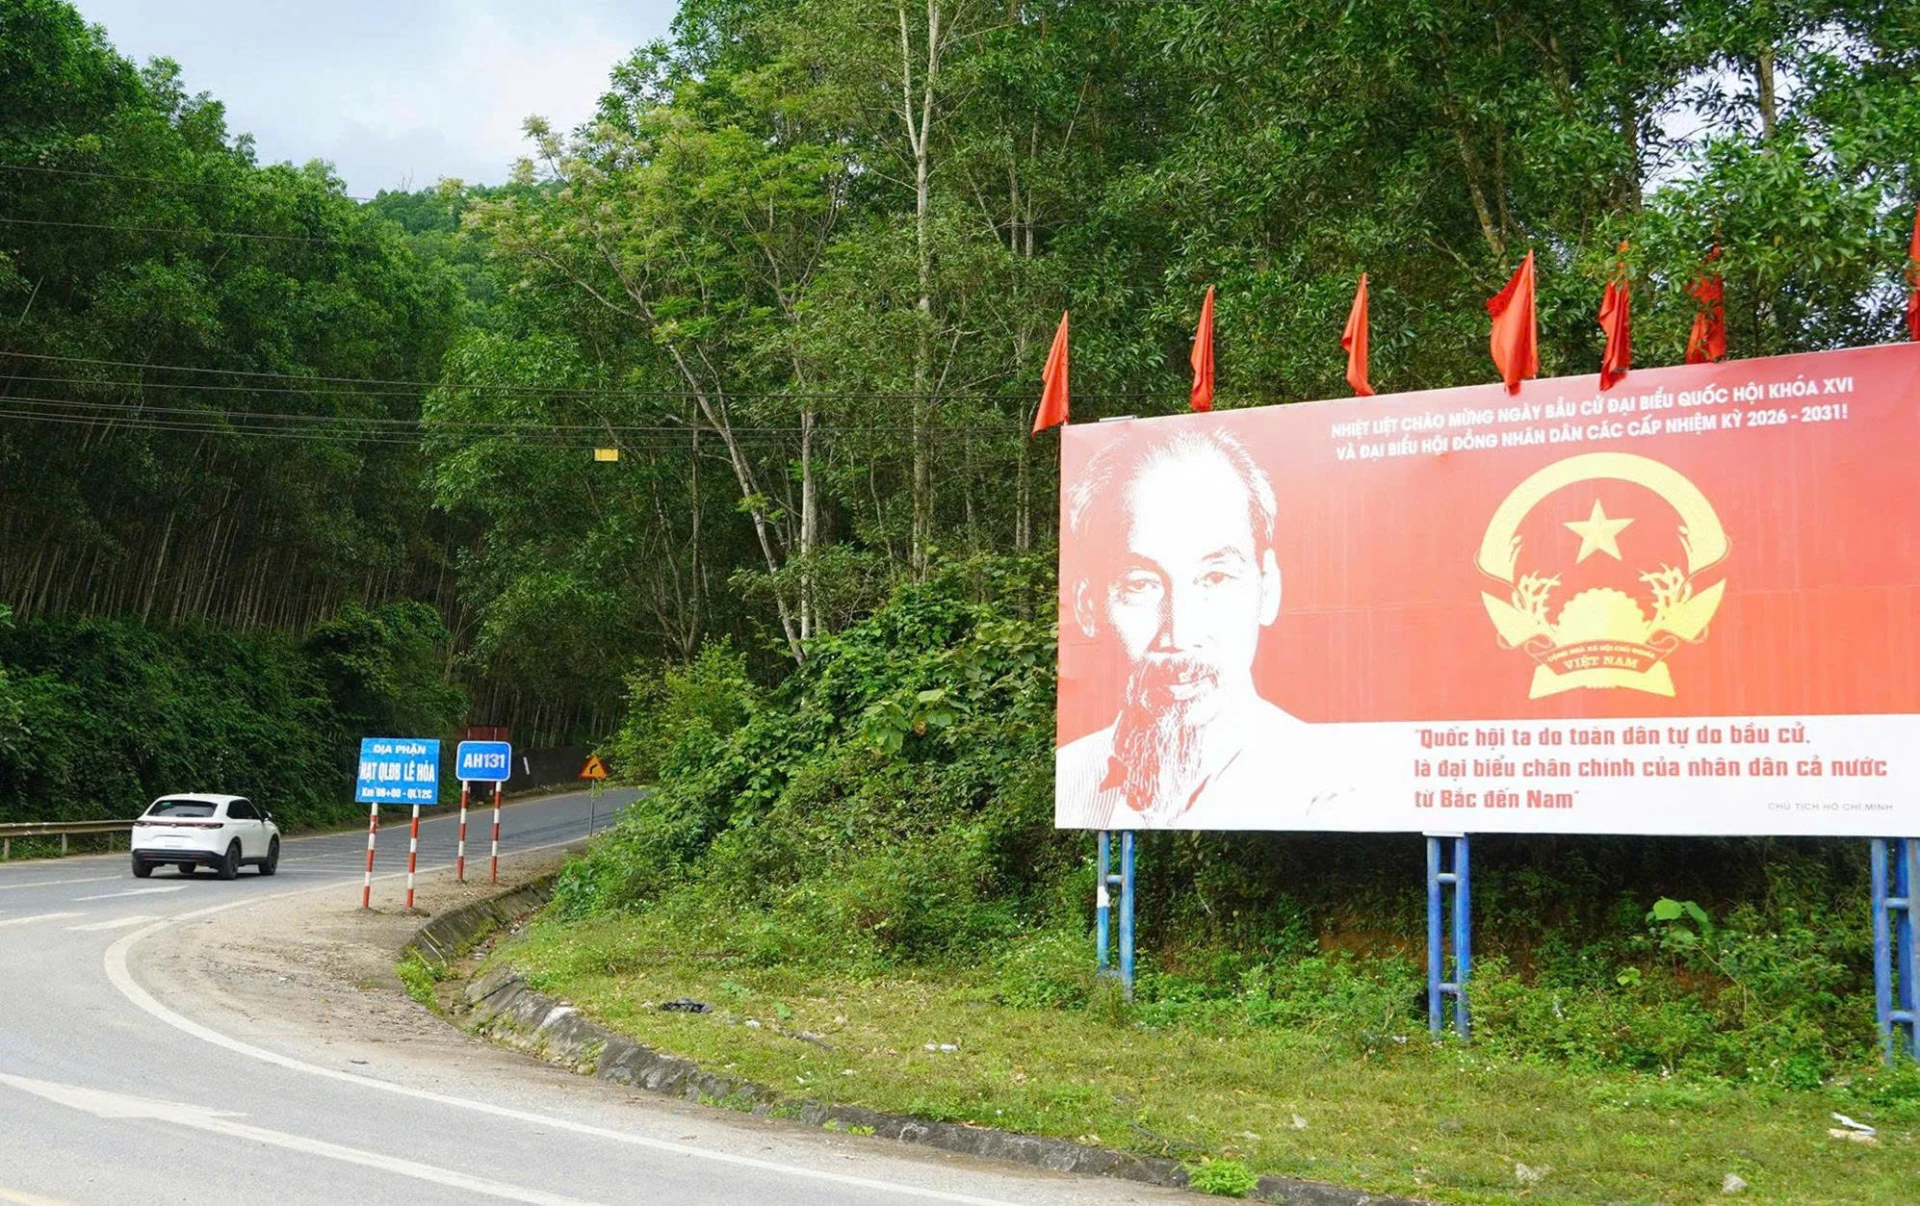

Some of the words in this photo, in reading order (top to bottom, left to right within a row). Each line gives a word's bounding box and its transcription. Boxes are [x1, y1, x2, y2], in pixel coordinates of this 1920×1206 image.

[1331, 421, 1368, 440] NHIỆT
[1373, 418, 1398, 437] LIỆT
[1401, 412, 1445, 431] CHÀO
[1449, 408, 1494, 426] MỪNG
[1498, 403, 1541, 422] NGÀY
[1546, 397, 1576, 419] BẦU
[1580, 397, 1604, 417] CỬ
[1608, 398, 1635, 414] ĐẠI
[1640, 386, 1673, 410] BIỂU
[1678, 383, 1728, 406] QUỐC
[1733, 382, 1764, 404] HỘI
[1769, 375, 1817, 398] KHÓA
[1823, 377, 1853, 393] XVI
[1336, 442, 1356, 460] VÀ
[1360, 442, 1384, 461] ĐẠI
[1388, 433, 1417, 456] BIỂU
[1422, 434, 1448, 456] HỘI
[1452, 427, 1498, 449] ĐỒNG
[1502, 427, 1545, 447] NHÂN
[1550, 423, 1582, 442] DÂN
[1586, 420, 1624, 439] CÁC
[1627, 413, 1662, 437] CẤP
[1666, 411, 1716, 435] NHIỆM
[1721, 409, 1742, 429] KỲ
[1747, 408, 1788, 426] 2026
[1801, 404, 1849, 422] 2031!
[1564, 655, 1600, 670] VIỆT
[1603, 656, 1639, 668] NAM
[1475, 728, 1505, 751] hội
[1512, 729, 1531, 746] ta
[1538, 729, 1562, 745] do
[1570, 727, 1615, 745] toàn
[1623, 726, 1660, 744] dân
[1668, 727, 1689, 749] tự
[1696, 725, 1722, 744] do
[1730, 723, 1770, 744] bầu
[395, 743, 426, 756] PHẬN
[416, 760, 435, 782] HÓA
[463, 753, 505, 768] AH131
[1414, 758, 1431, 776] là
[1438, 759, 1466, 781] đại
[1474, 754, 1515, 776] biểu
[1522, 758, 1571, 776] chân
[1578, 757, 1635, 776] chính
[1642, 756, 1680, 776] của
[1688, 757, 1740, 776] nhân
[1748, 757, 1788, 776] dân
[1797, 755, 1822, 776] cả
[1831, 756, 1888, 776] nước
[1415, 789, 1434, 808] từ
[1440, 787, 1476, 808] Bắc
[1484, 787, 1520, 808] đến
[1865, 803, 1893, 811] MINH
